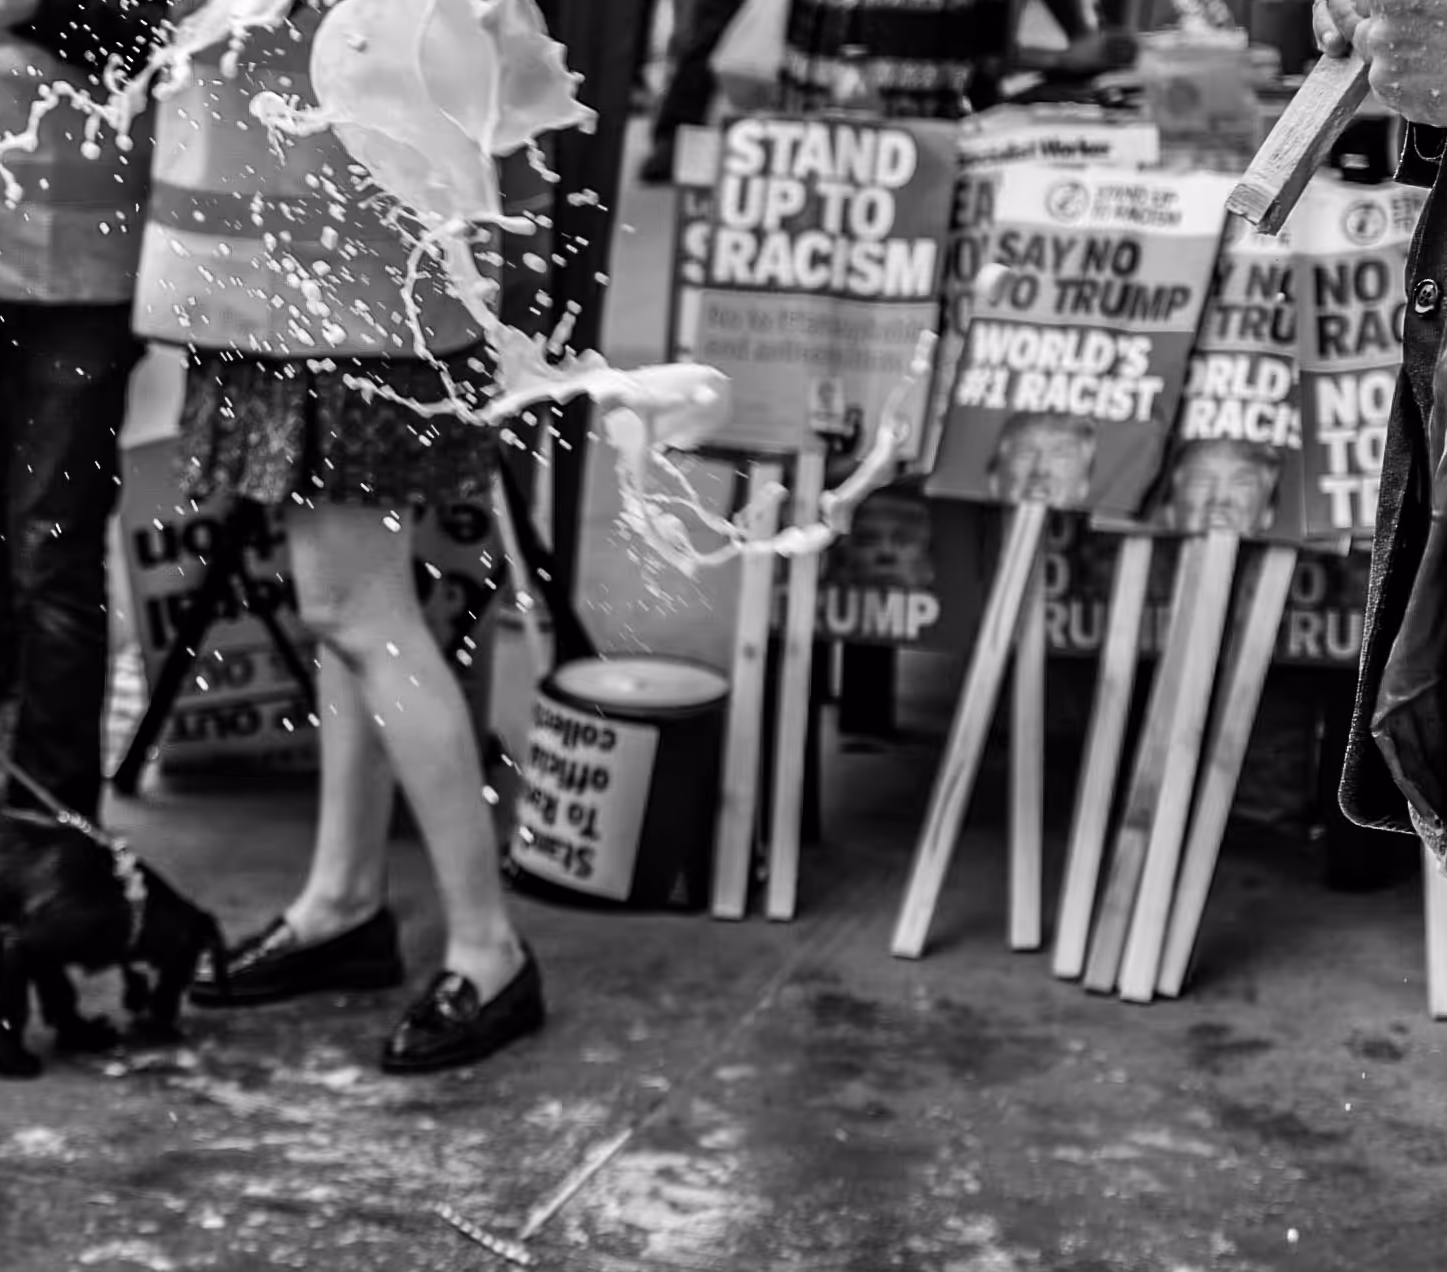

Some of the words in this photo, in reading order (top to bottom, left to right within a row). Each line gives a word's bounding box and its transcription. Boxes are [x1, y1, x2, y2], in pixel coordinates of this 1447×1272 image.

[727, 118, 918, 189] STAND
[720, 176, 806, 231] UP
[814, 182, 896, 242] TO
[713, 228, 938, 297] RACISM
[995, 231, 1076, 273] SAY
[1081, 237, 1141, 277] NO
[1055, 279, 1192, 321] TRUMP
[1314, 259, 1390, 307] NO
[972, 322, 1153, 378] WORLD'S
[1213, 304, 1296, 346] TRU
[957, 368, 1010, 409] #1
[1012, 372, 1164, 424] RACIST
[1316, 370, 1396, 429] NO
[1317, 425, 1386, 476] TO
